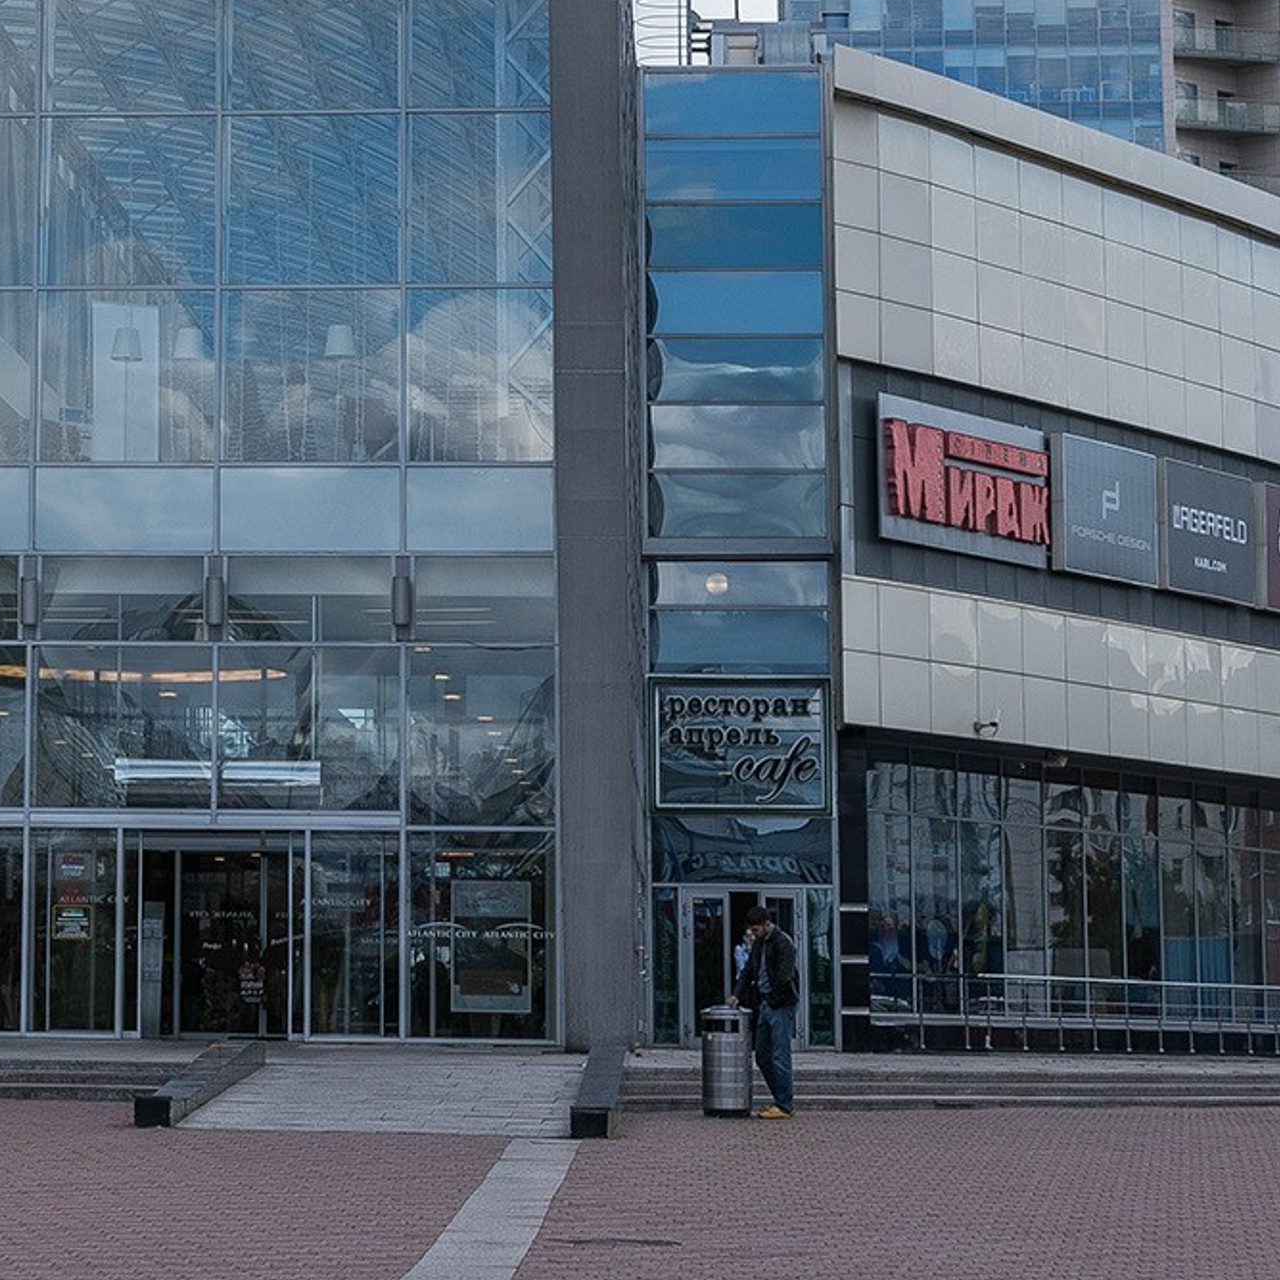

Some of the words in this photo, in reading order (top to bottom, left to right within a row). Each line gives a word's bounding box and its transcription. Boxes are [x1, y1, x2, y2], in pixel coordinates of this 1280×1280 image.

[1172, 504, 1247, 545] LAGERFELD
[1117, 534, 1152, 552] DESIGN
[666, 695, 812, 721] ресторан
[668, 725, 781, 749] апрель
[732, 734, 820, 802] cafe
[106, 894, 130, 903] CY
